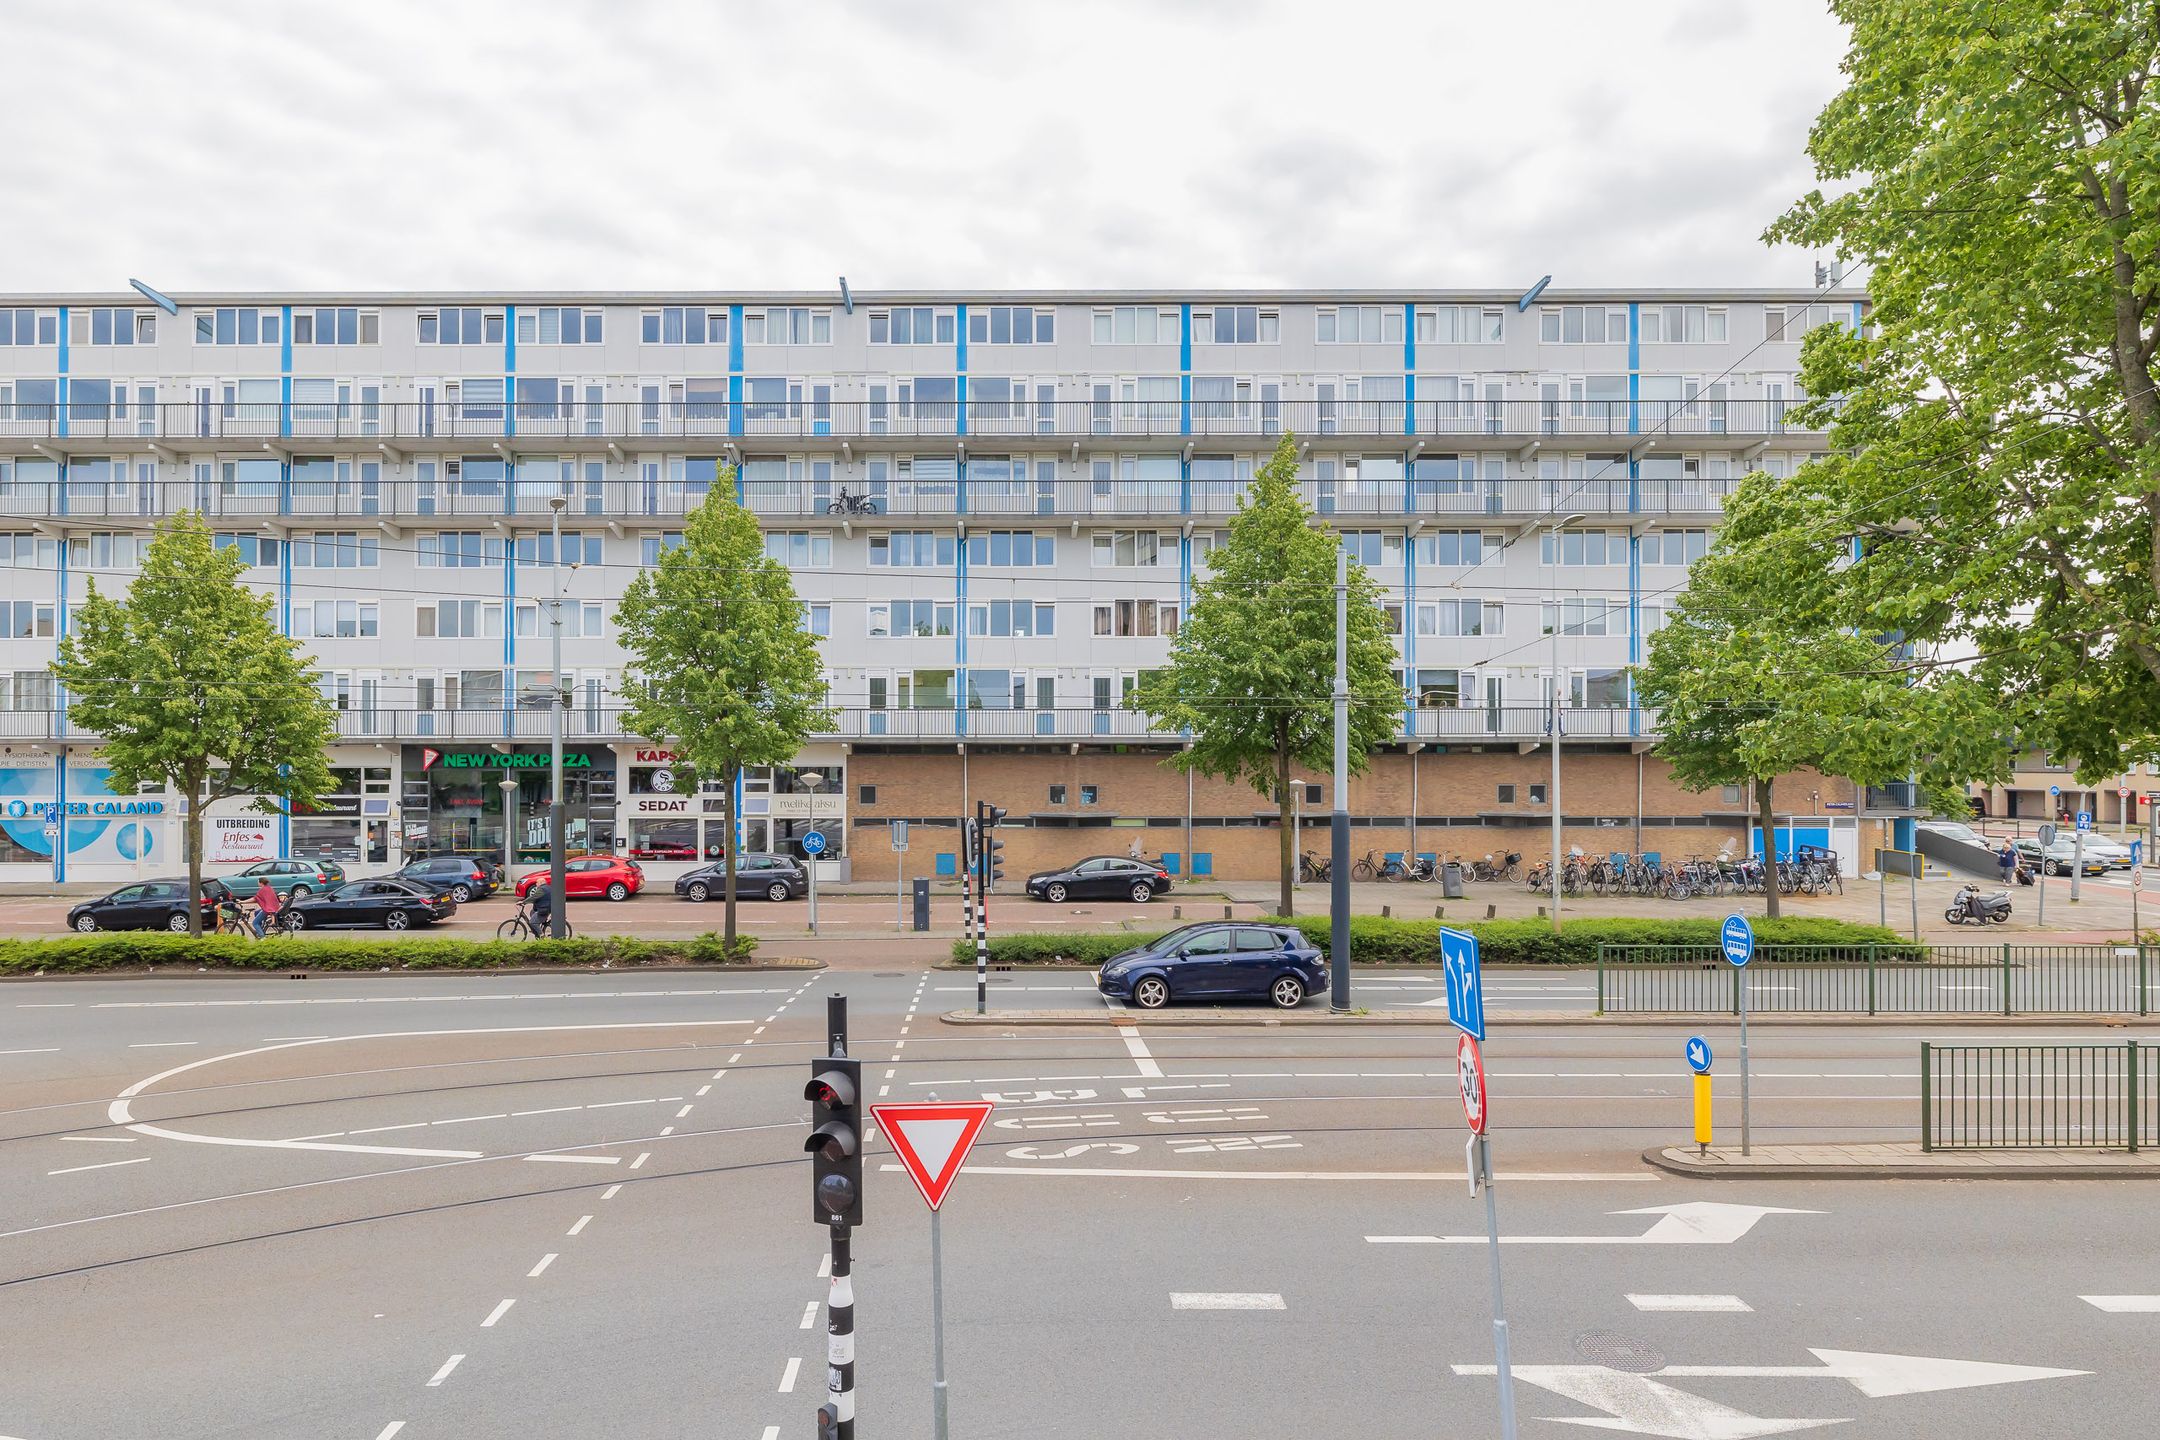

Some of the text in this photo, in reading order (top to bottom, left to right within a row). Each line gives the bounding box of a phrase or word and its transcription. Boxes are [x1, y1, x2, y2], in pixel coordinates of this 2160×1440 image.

[443, 752, 488, 767] NEW
[488, 752, 538, 767] YORK
[539, 752, 592, 767] PZA
[92, 801, 164, 815] CALAND
[638, 800, 689, 812] SEDAT
[814, 799, 837, 809] aksu
[216, 818, 271, 829] UITBREIDING
[223, 831, 251, 844] Enfes
[221, 841, 264, 851] Restaurant
[1462, 1061, 1478, 1105] 30
[981, 1088, 1141, 1161] BUS
